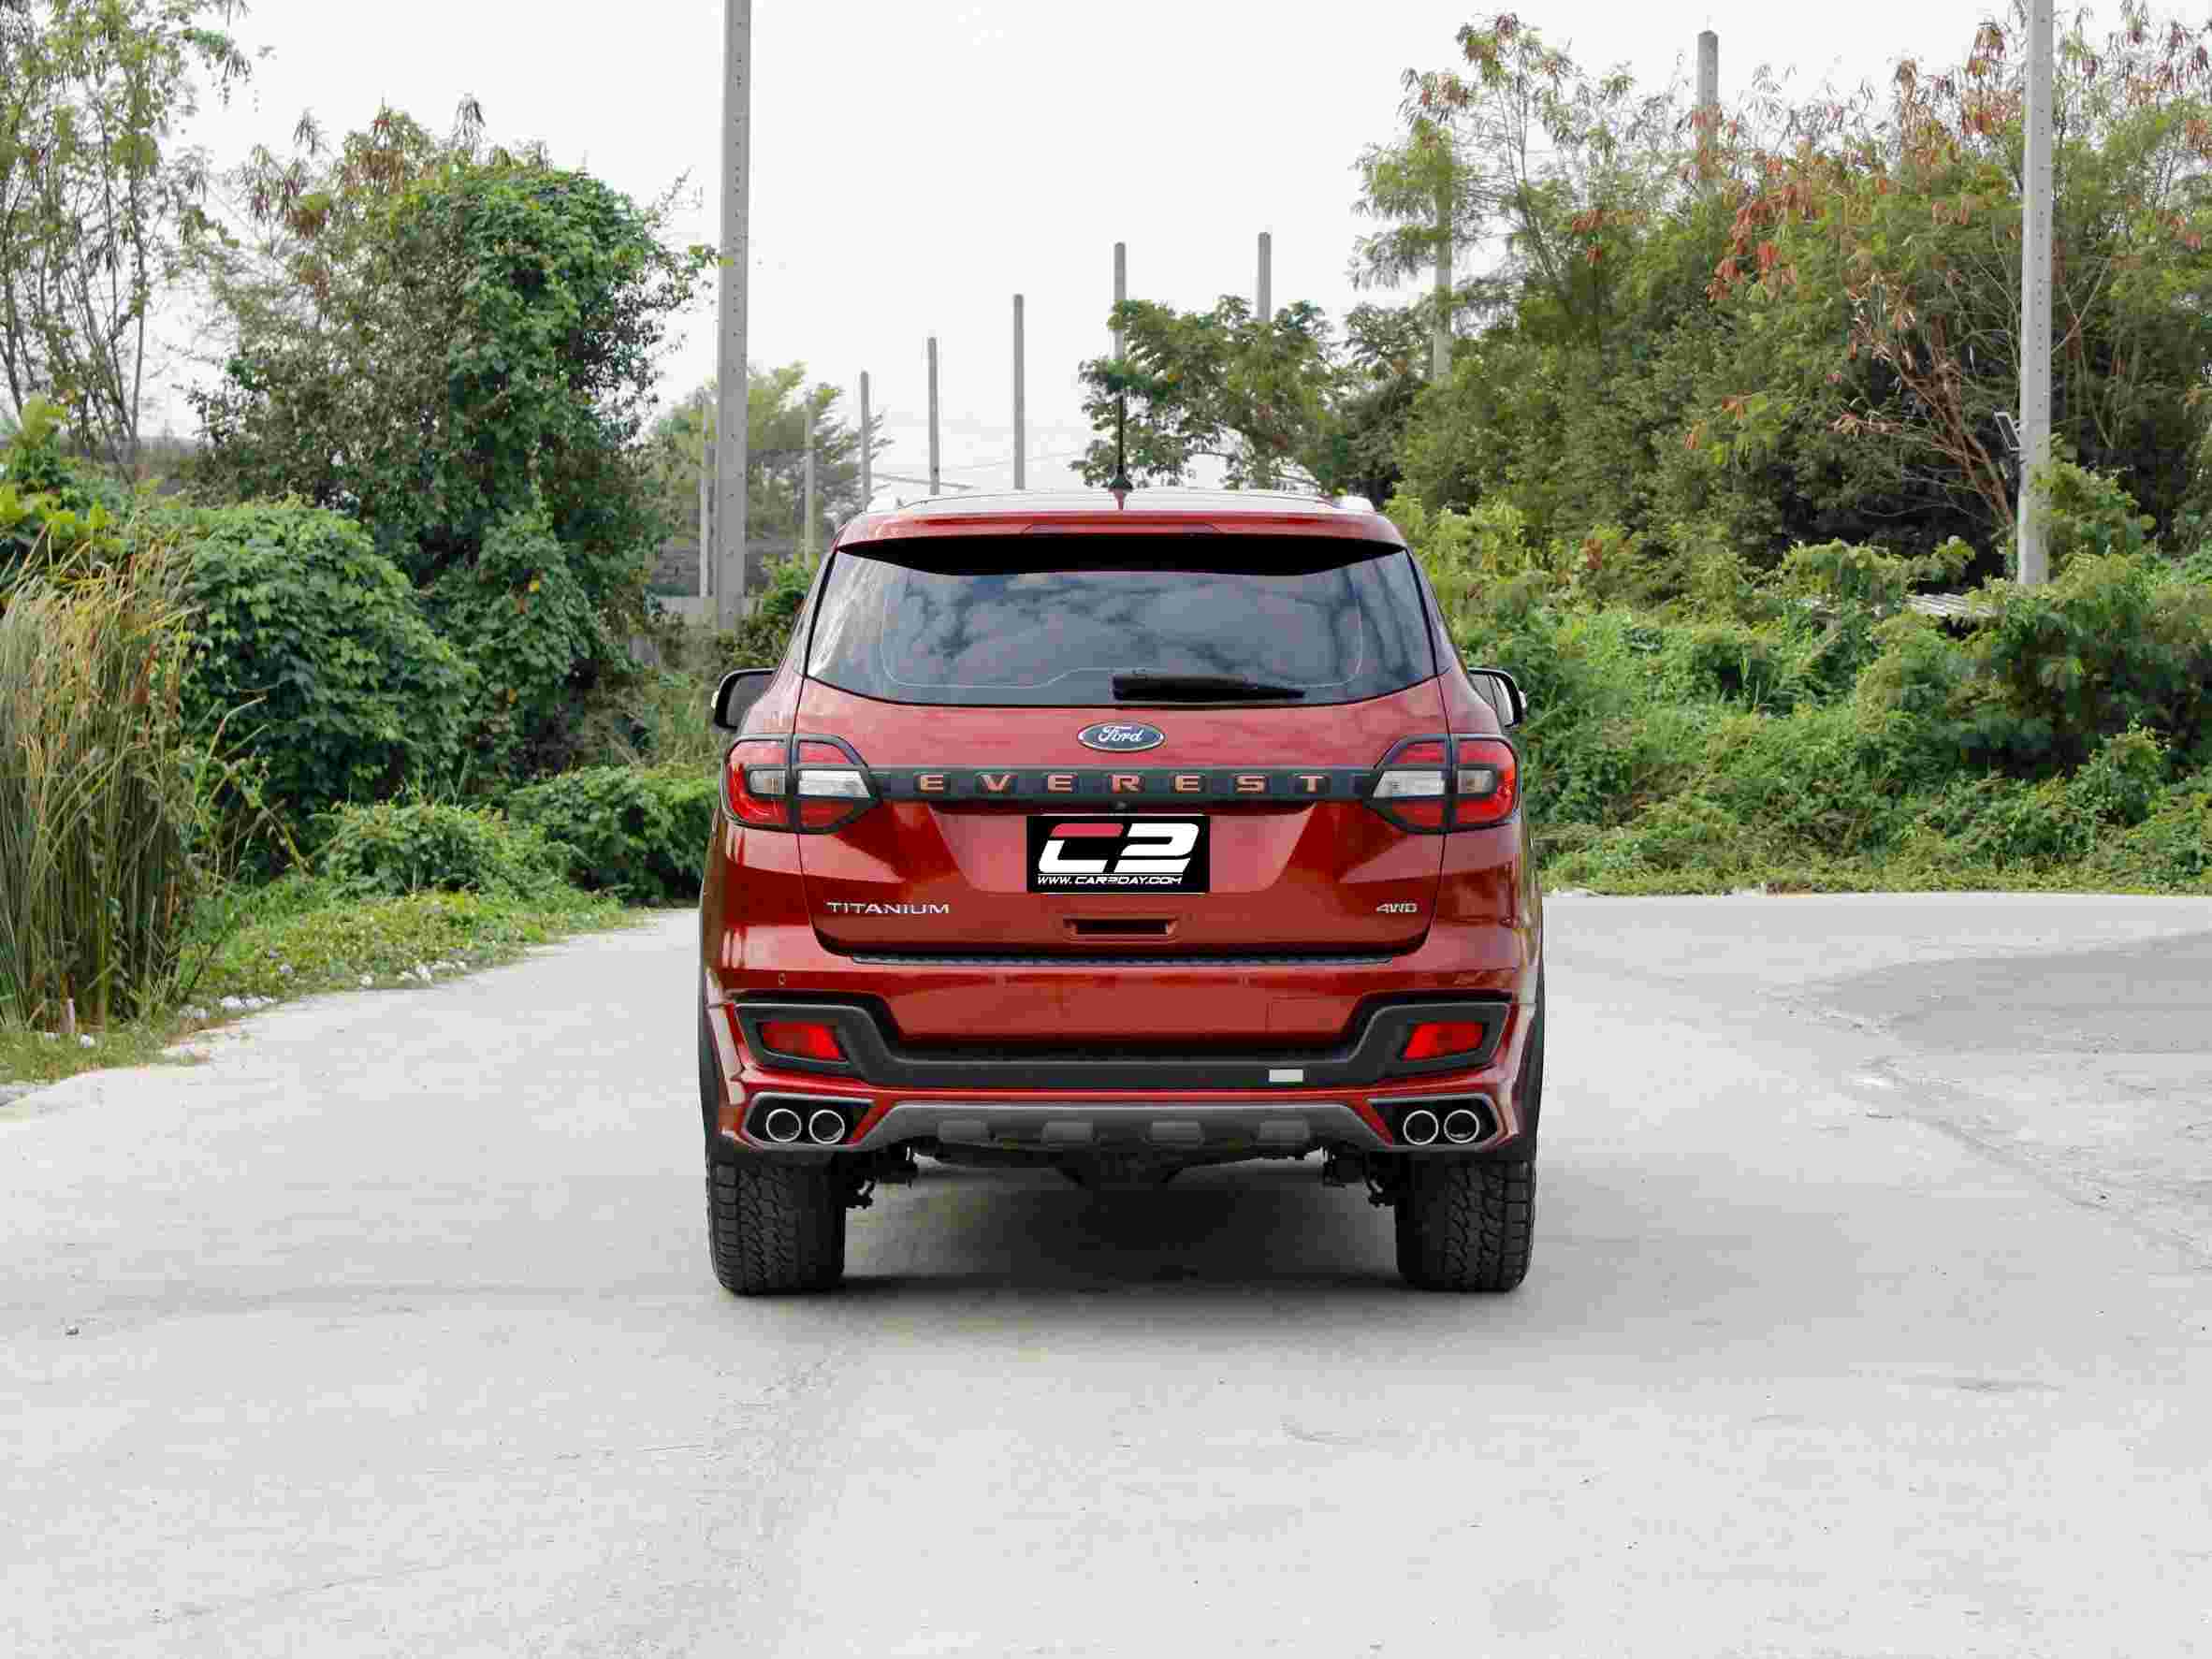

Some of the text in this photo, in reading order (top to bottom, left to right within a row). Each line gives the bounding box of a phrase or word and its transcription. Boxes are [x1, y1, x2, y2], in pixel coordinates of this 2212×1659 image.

[1098, 725, 1144, 742] Ford
[919, 773, 1330, 793] EVEREST
[1039, 822, 1200, 873] C2
[826, 901, 950, 914] TITANIUM
[1375, 902, 1418, 914] 4WD
